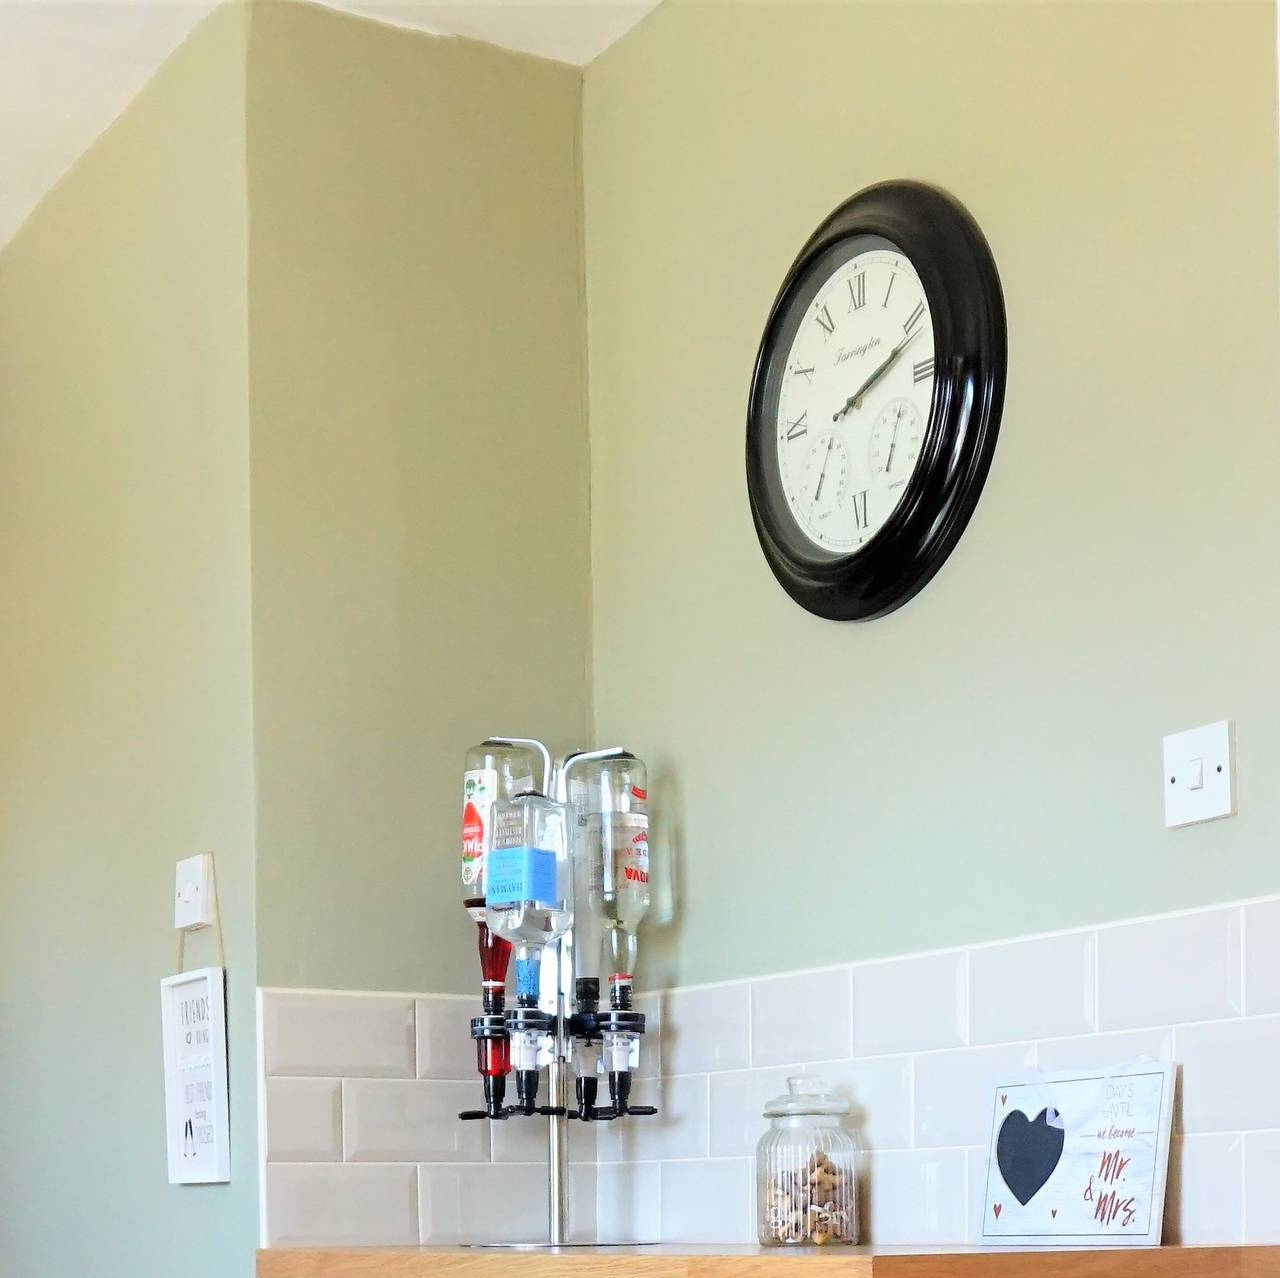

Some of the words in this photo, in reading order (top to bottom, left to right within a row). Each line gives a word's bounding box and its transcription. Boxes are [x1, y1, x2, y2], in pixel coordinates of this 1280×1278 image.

[847, 271, 866, 313] XII
[882, 271, 897, 308] I
[816, 304, 836, 341] XI
[903, 299, 926, 336] II
[1105, 1083, 1135, 1100] DAYS
[1098, 1149, 1132, 1185] Mr.
[1083, 1175, 1095, 1202] &
[1094, 1191, 1136, 1227] Mrs.
